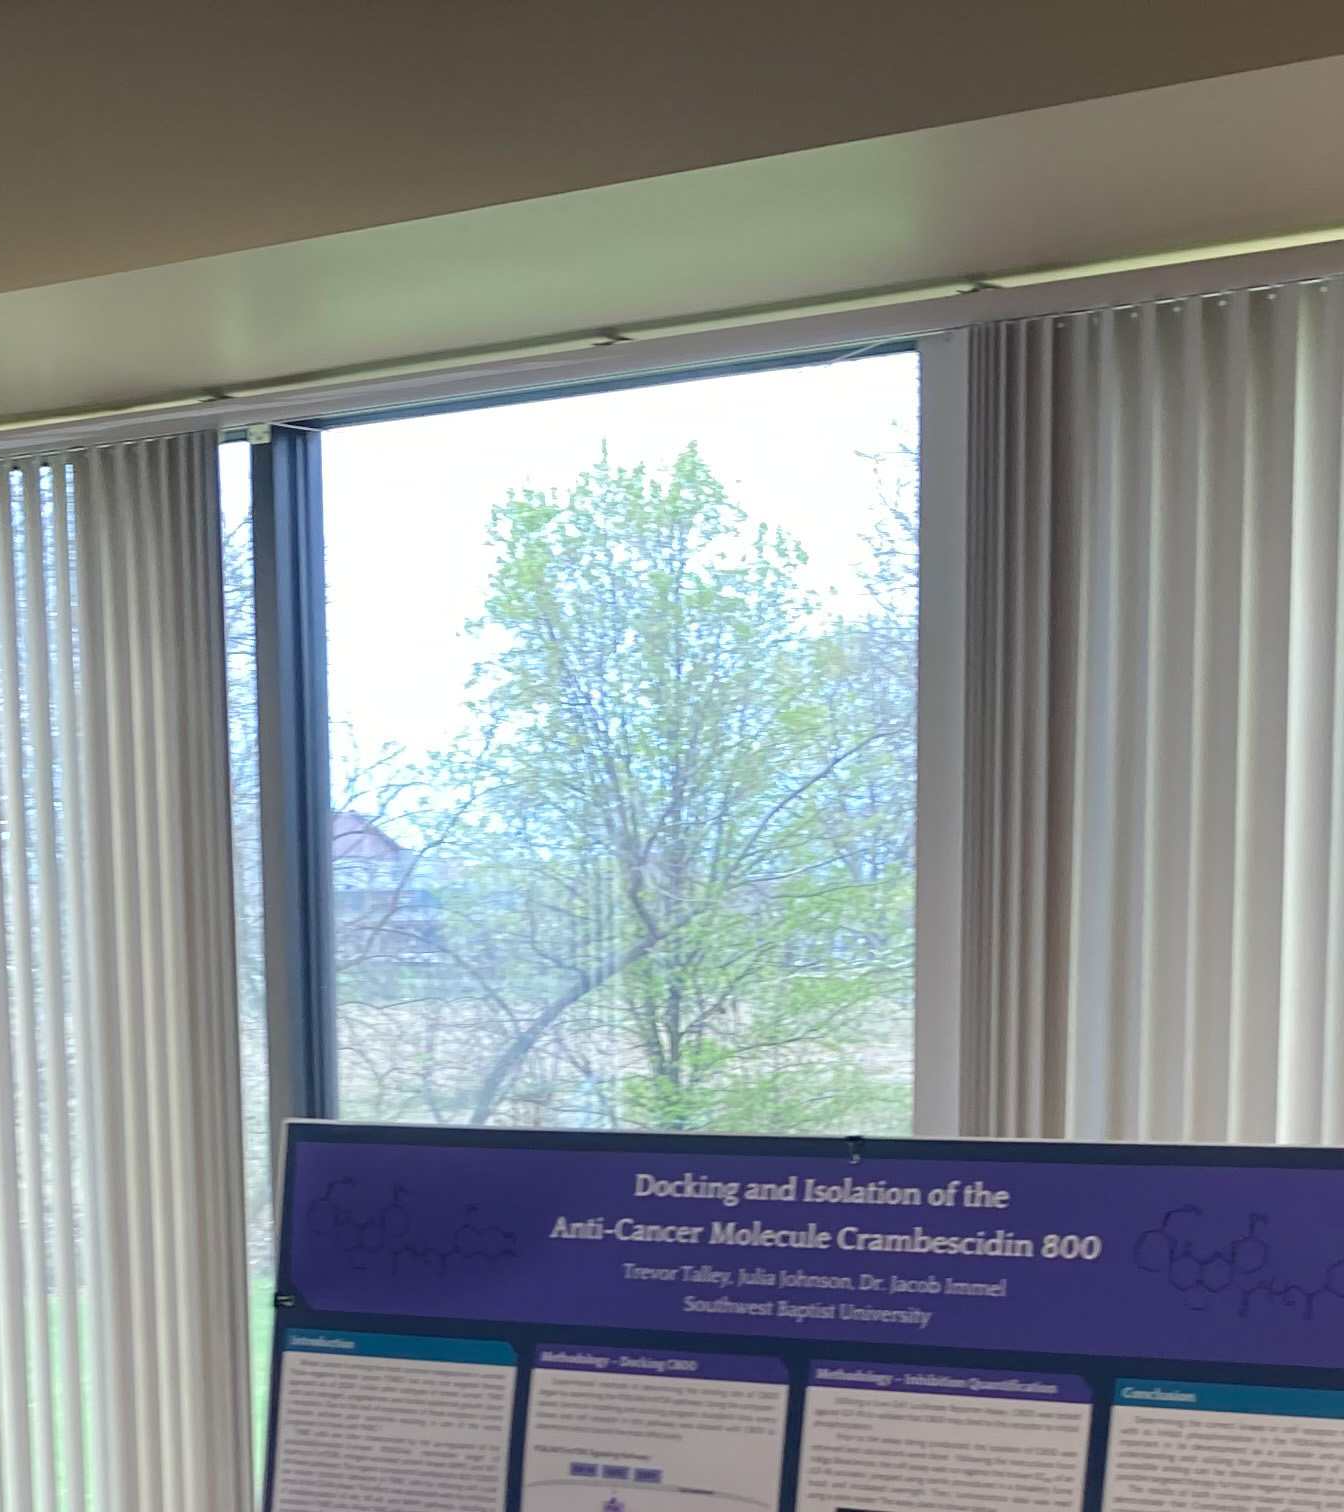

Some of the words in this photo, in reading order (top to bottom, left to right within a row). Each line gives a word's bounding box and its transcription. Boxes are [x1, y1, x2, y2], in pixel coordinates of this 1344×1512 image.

[633, 1172, 740, 1207] Docking
[744, 1175, 798, 1202] and
[803, 1177, 922, 1206] Isolation
[927, 1180, 961, 1208] of
[963, 1181, 1010, 1210] the
[549, 1216, 704, 1245] Anti-Cancer
[709, 1221, 833, 1250] Molecule
[836, 1226, 1034, 1258] Crambescidin
[1040, 1234, 1102, 1261] 800
[622, 1262, 678, 1283] Trevor
[737, 1267, 776, 1288] Julia
[858, 1273, 886, 1292] Dr.
[890, 1274, 941, 1295] Jacob
[683, 1295, 773, 1318] Southwest
[777, 1299, 835, 1323] Baptist
[839, 1303, 932, 1330] University
